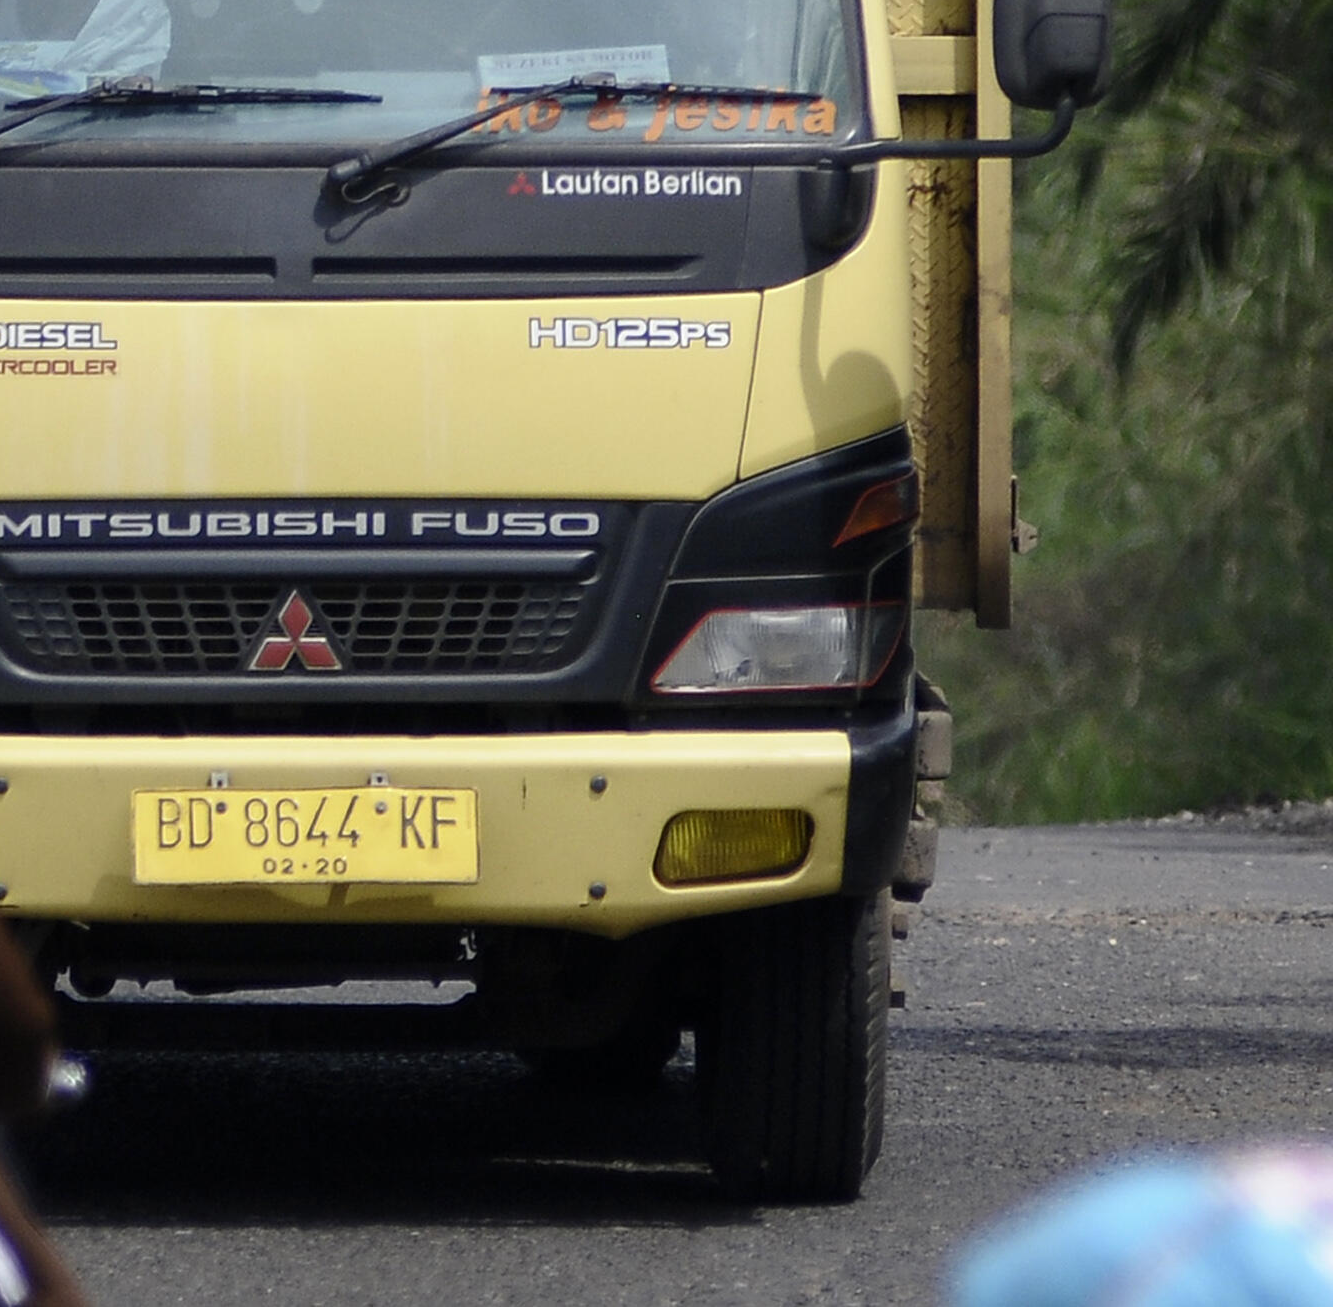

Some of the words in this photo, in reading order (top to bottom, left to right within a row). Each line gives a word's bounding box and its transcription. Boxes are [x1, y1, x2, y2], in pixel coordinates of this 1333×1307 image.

[542, 168, 638, 195] Lautan
[644, 169, 742, 196] Berlian
[411, 512, 600, 536] FUSO
[157, 798, 213, 849] BD
[244, 794, 360, 849] 8644
[400, 795, 457, 849] KF
